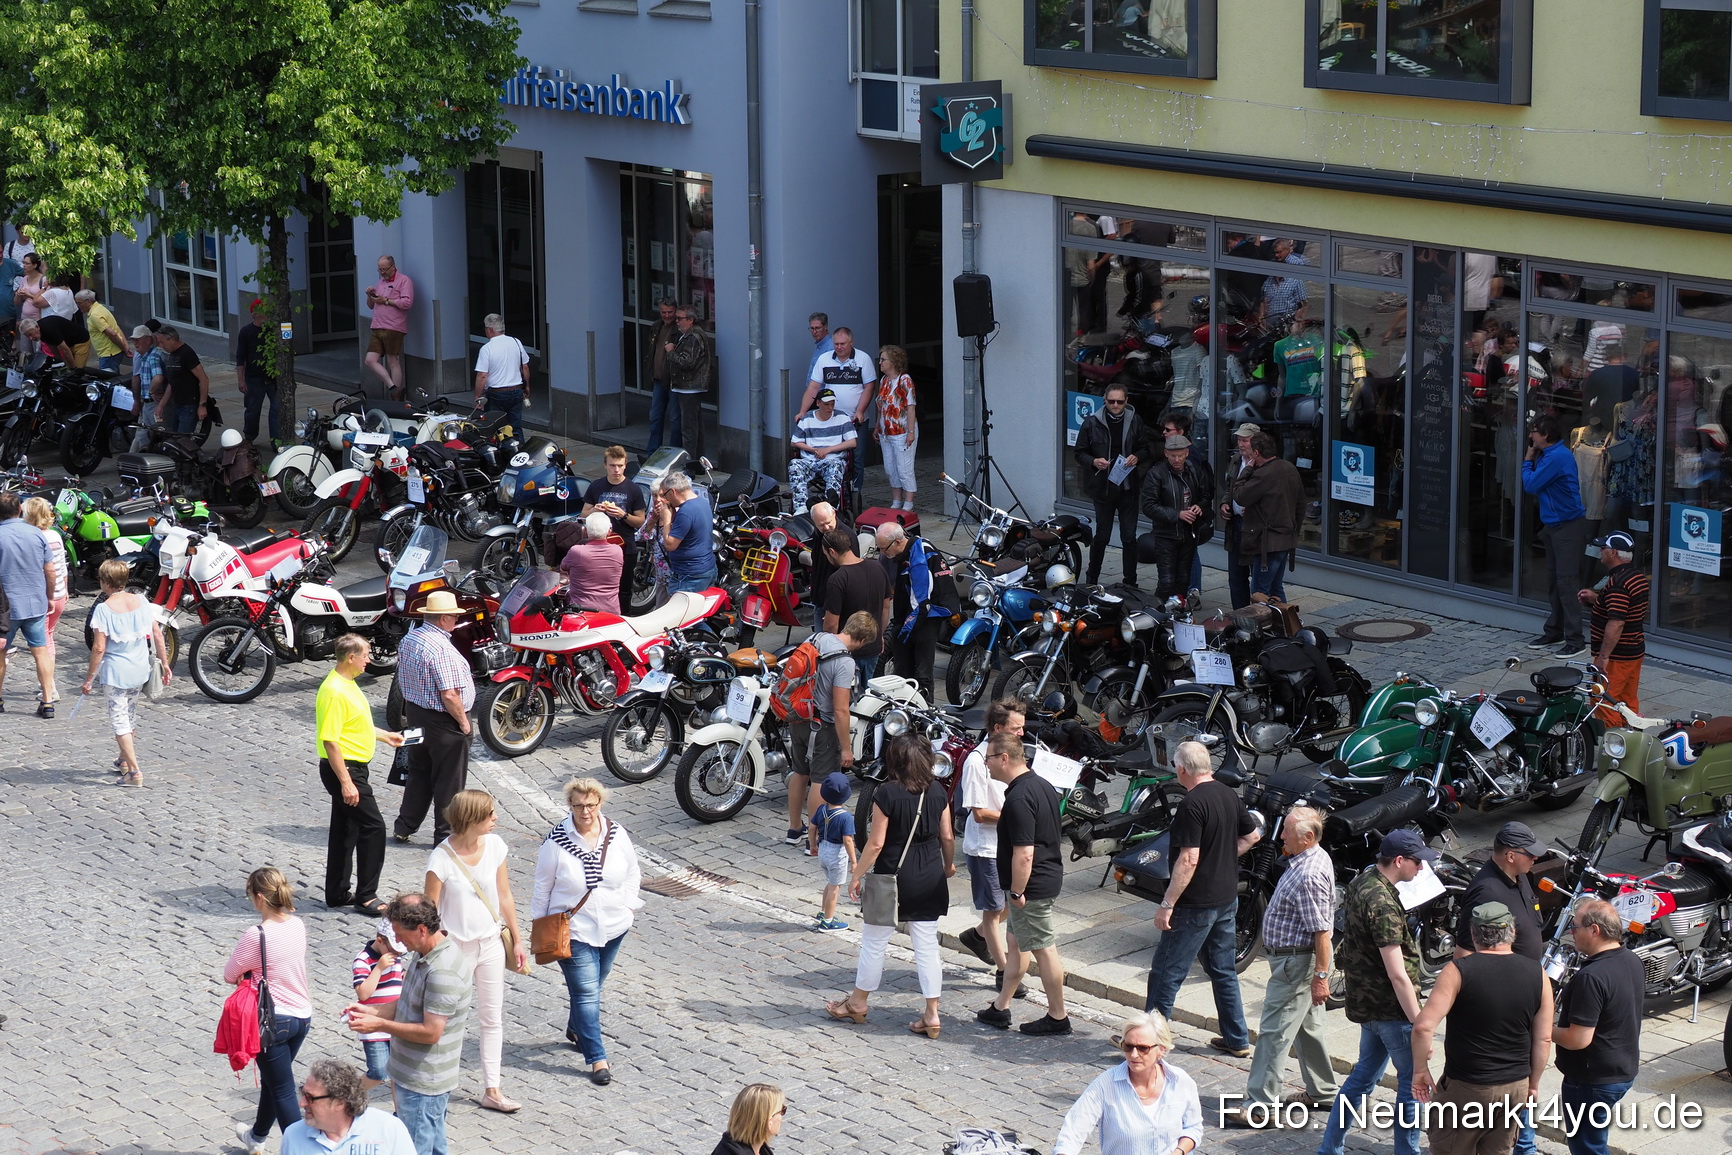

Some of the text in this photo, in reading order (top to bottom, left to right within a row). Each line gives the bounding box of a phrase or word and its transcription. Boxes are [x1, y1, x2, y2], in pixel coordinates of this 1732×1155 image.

[497, 64, 692, 125] aiffeisenbank
[958, 111, 987, 152] G2
[512, 455, 527, 464] 145
[1690, 521, 1700, 534] G2
[520, 632, 560, 641] HONDA
[1214, 657, 1227, 666] 280
[735, 692, 745, 702] 99
[1056, 763, 1074, 774] 527
[1628, 894, 1645, 906] 620
[349, 1143, 380, 1155] BLUE
